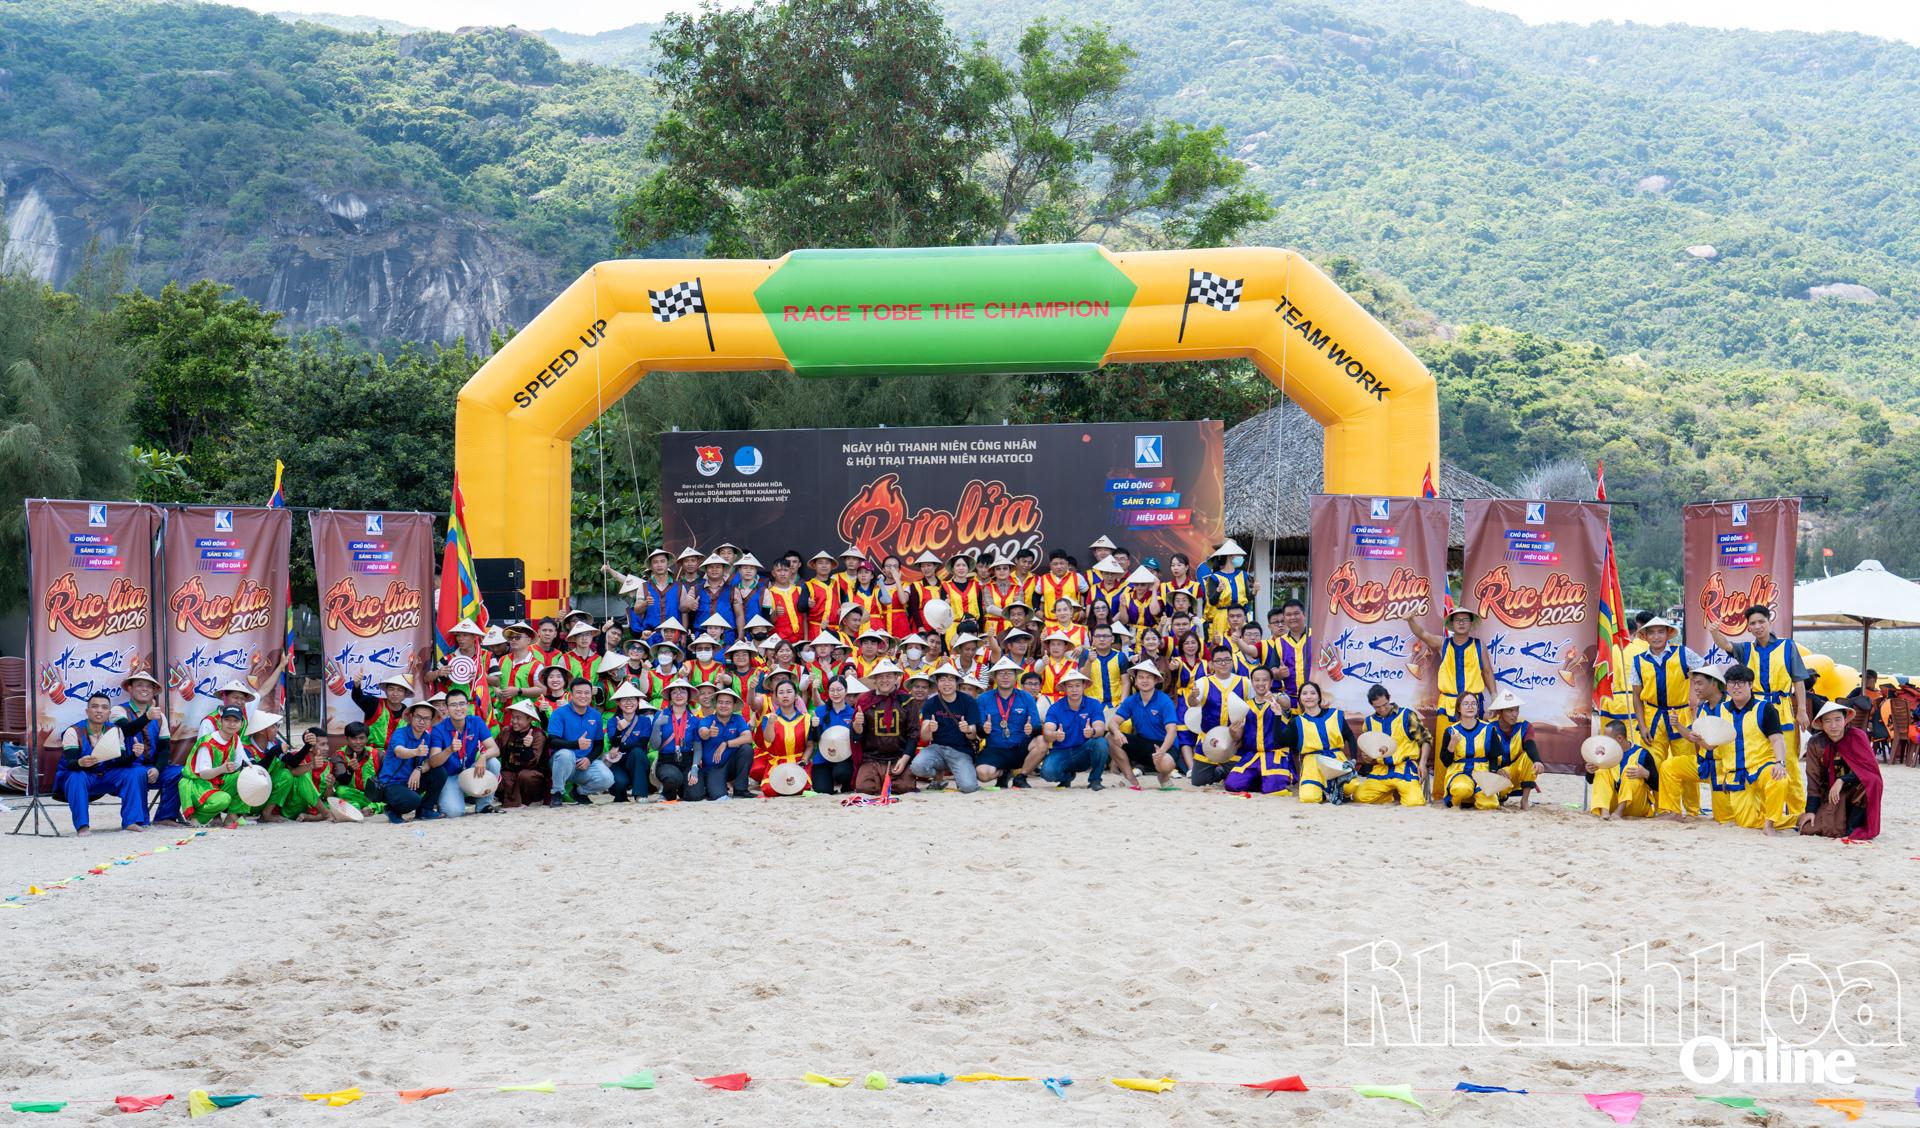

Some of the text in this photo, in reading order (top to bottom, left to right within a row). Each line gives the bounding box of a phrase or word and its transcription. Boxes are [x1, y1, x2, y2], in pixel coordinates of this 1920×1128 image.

[783, 300, 1110, 323] RACE TOBE THE CHAMPION
[513, 318, 609, 409] SPEED UP
[842, 438, 1037, 455] NGÀY HỘI THANH NIÊN CÔNG NHÂN
[846, 453, 1033, 468] & HỘI TRẠI THANH NIÊN KHATOCO
[1113, 480, 1153, 490] CHỦ ĐỘNG
[1122, 497, 1162, 506] SÁNG TẠO
[841, 475, 1038, 579] Rực lửa
[1136, 512, 1174, 522] HIỆU QUẢ
[1327, 561, 1430, 623] Rực lửa
[1475, 566, 1587, 629] Rực lửa
[45, 574, 147, 639] Rực lửa
[170, 576, 232, 639] Rực
[325, 577, 421, 637] Rực lửa
[1385, 597, 1429, 620] 2026
[1539, 604, 1585, 626] 2026
[106, 608, 146, 635] 2026
[229, 608, 270, 634] 2026
[383, 609, 420, 633] 2026
[64, 680, 121, 702] Khtoco
